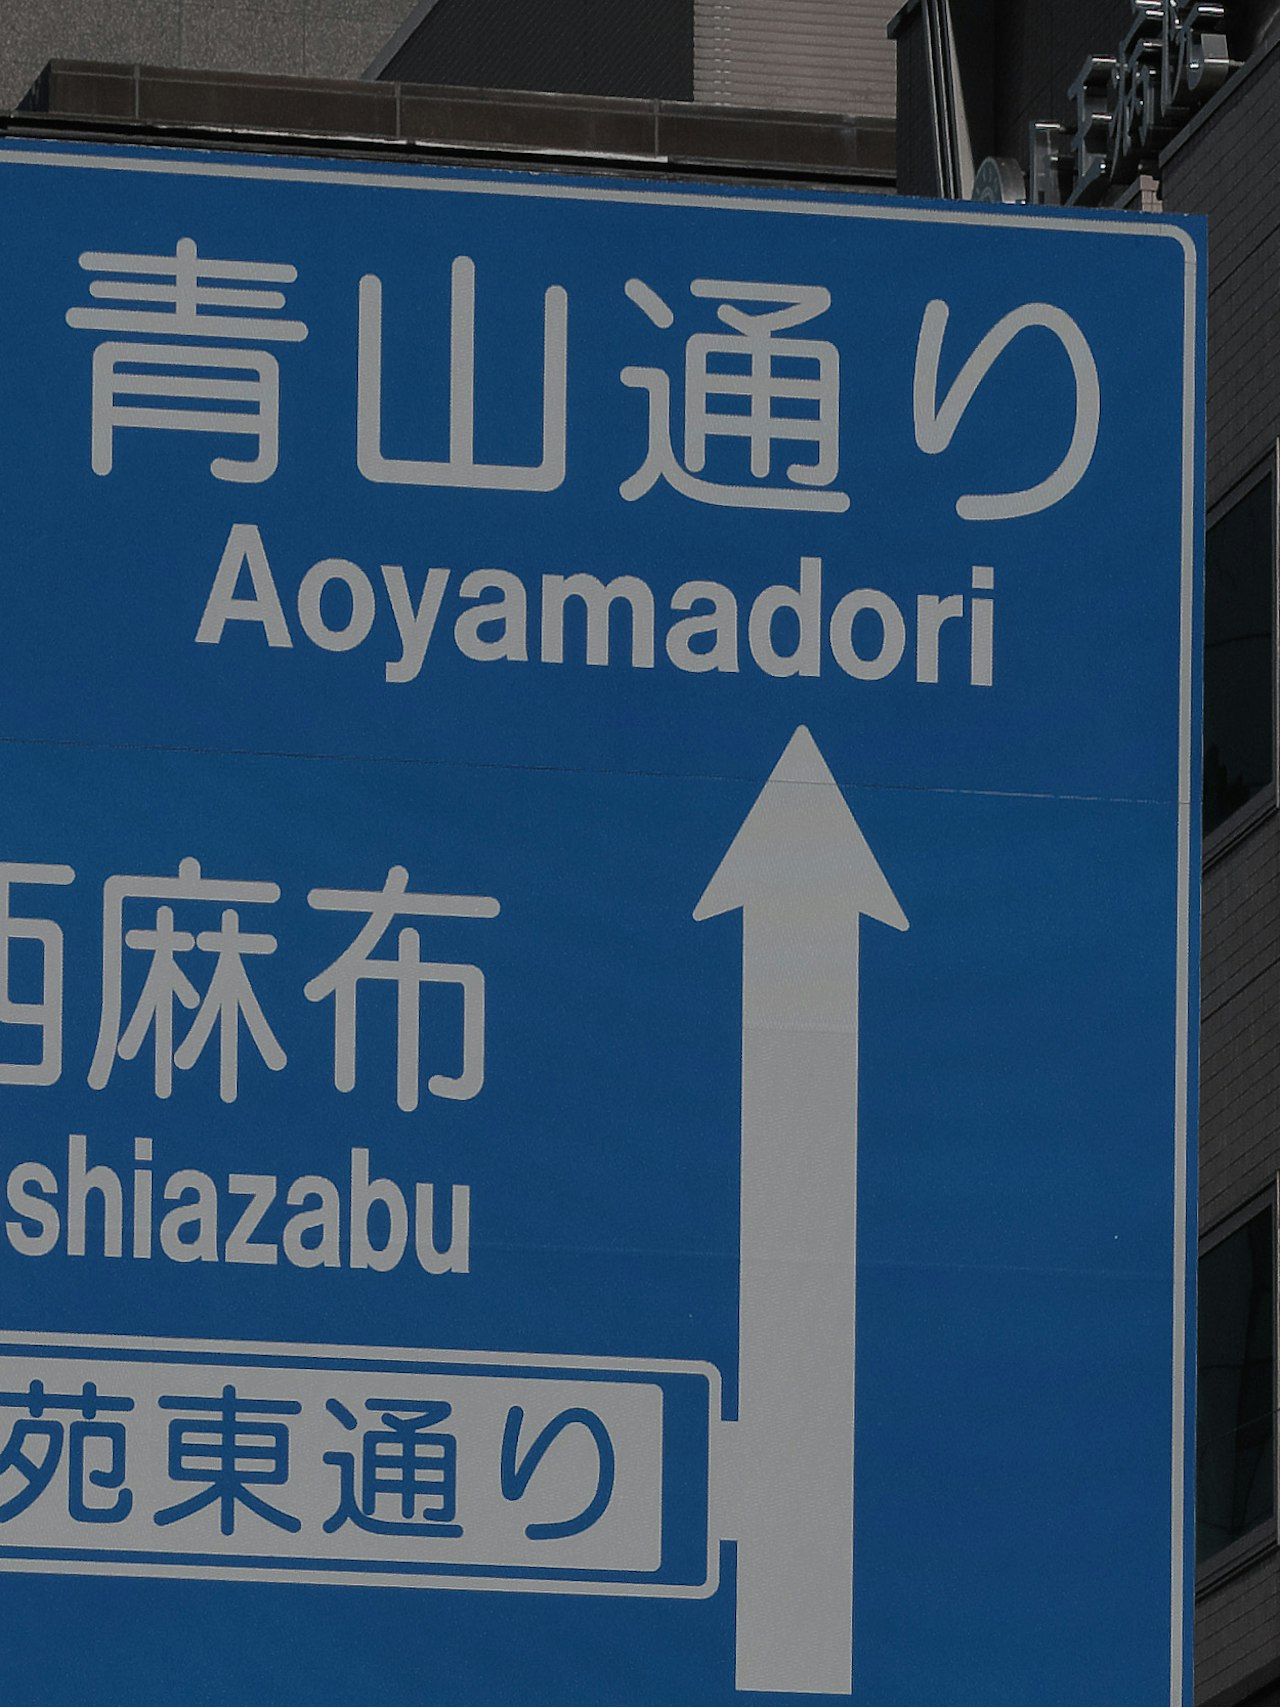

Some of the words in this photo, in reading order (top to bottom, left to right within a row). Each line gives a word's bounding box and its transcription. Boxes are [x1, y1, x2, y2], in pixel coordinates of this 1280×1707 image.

[65, 237, 1100, 520] 青山通り
[195, 523, 993, 686] Aoyamadori
